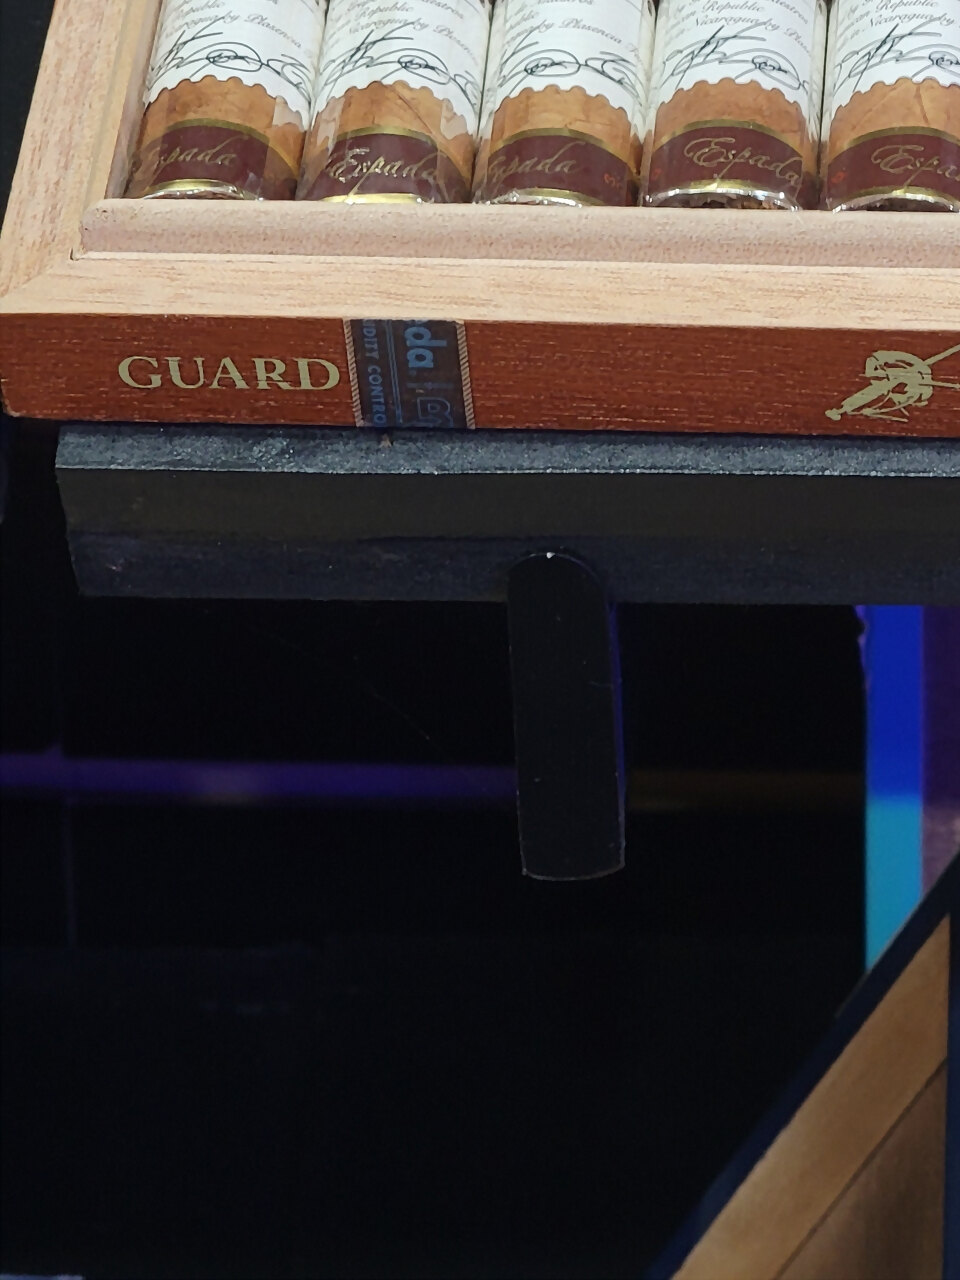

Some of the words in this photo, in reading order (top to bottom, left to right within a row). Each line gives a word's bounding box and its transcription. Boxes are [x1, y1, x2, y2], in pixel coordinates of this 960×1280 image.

[702, 1, 764, 13] Republic
[559, 18, 623, 44] Plasencia
[684, 137, 803, 187] Espada
[118, 355, 340, 390] GUARD
